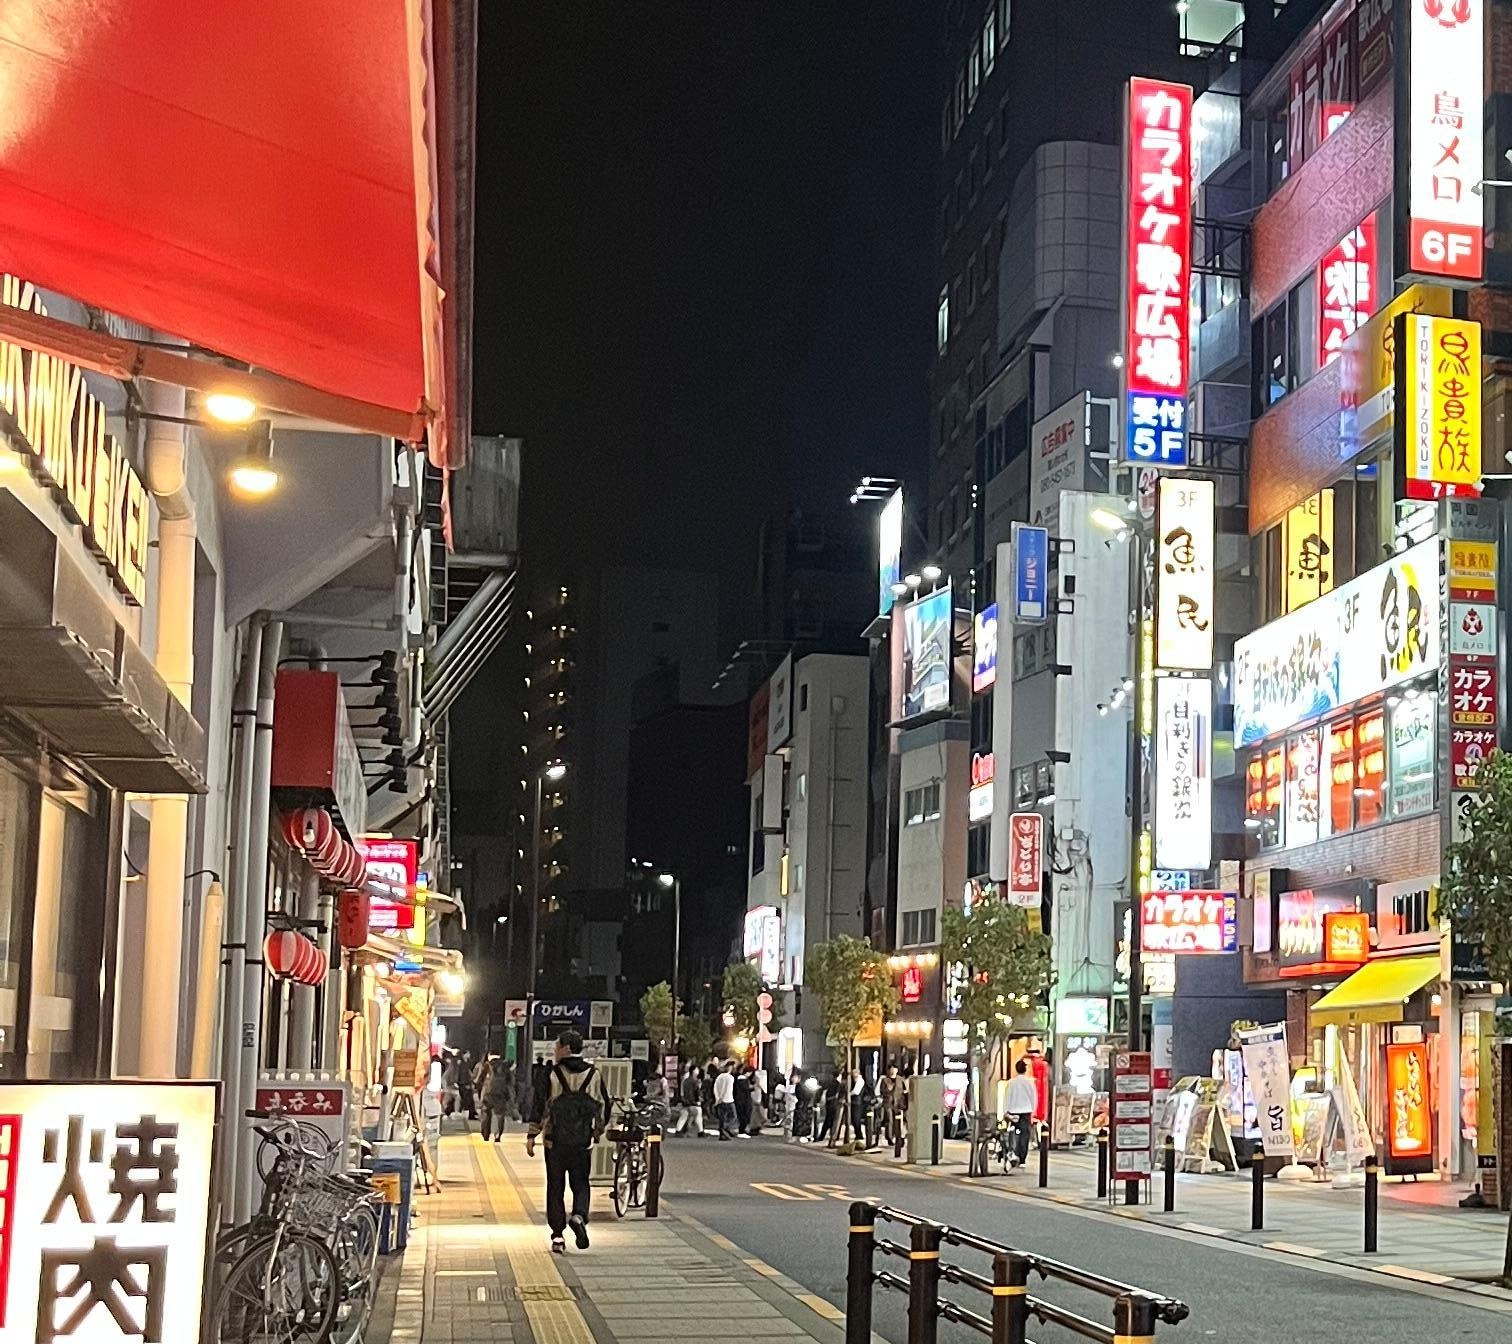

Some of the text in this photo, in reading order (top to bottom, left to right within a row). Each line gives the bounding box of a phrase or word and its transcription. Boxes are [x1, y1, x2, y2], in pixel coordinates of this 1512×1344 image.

[1431, 90, 1464, 204] 鳥メロ
[1135, 90, 1183, 388] カラオケ歌広場
[1421, 229, 1473, 265] 6F
[1133, 396, 1185, 428] 受付
[1437, 330, 1471, 473] 鳥貴族
[1133, 427, 1185, 458] 5F
[1164, 525, 1209, 632] 魚民
[1453, 668, 1492, 690] カラ
[1453, 691, 1493, 712] オケ
[1453, 730, 1495, 744] カラオケ
[1143, 893, 1223, 923] カラオケ
